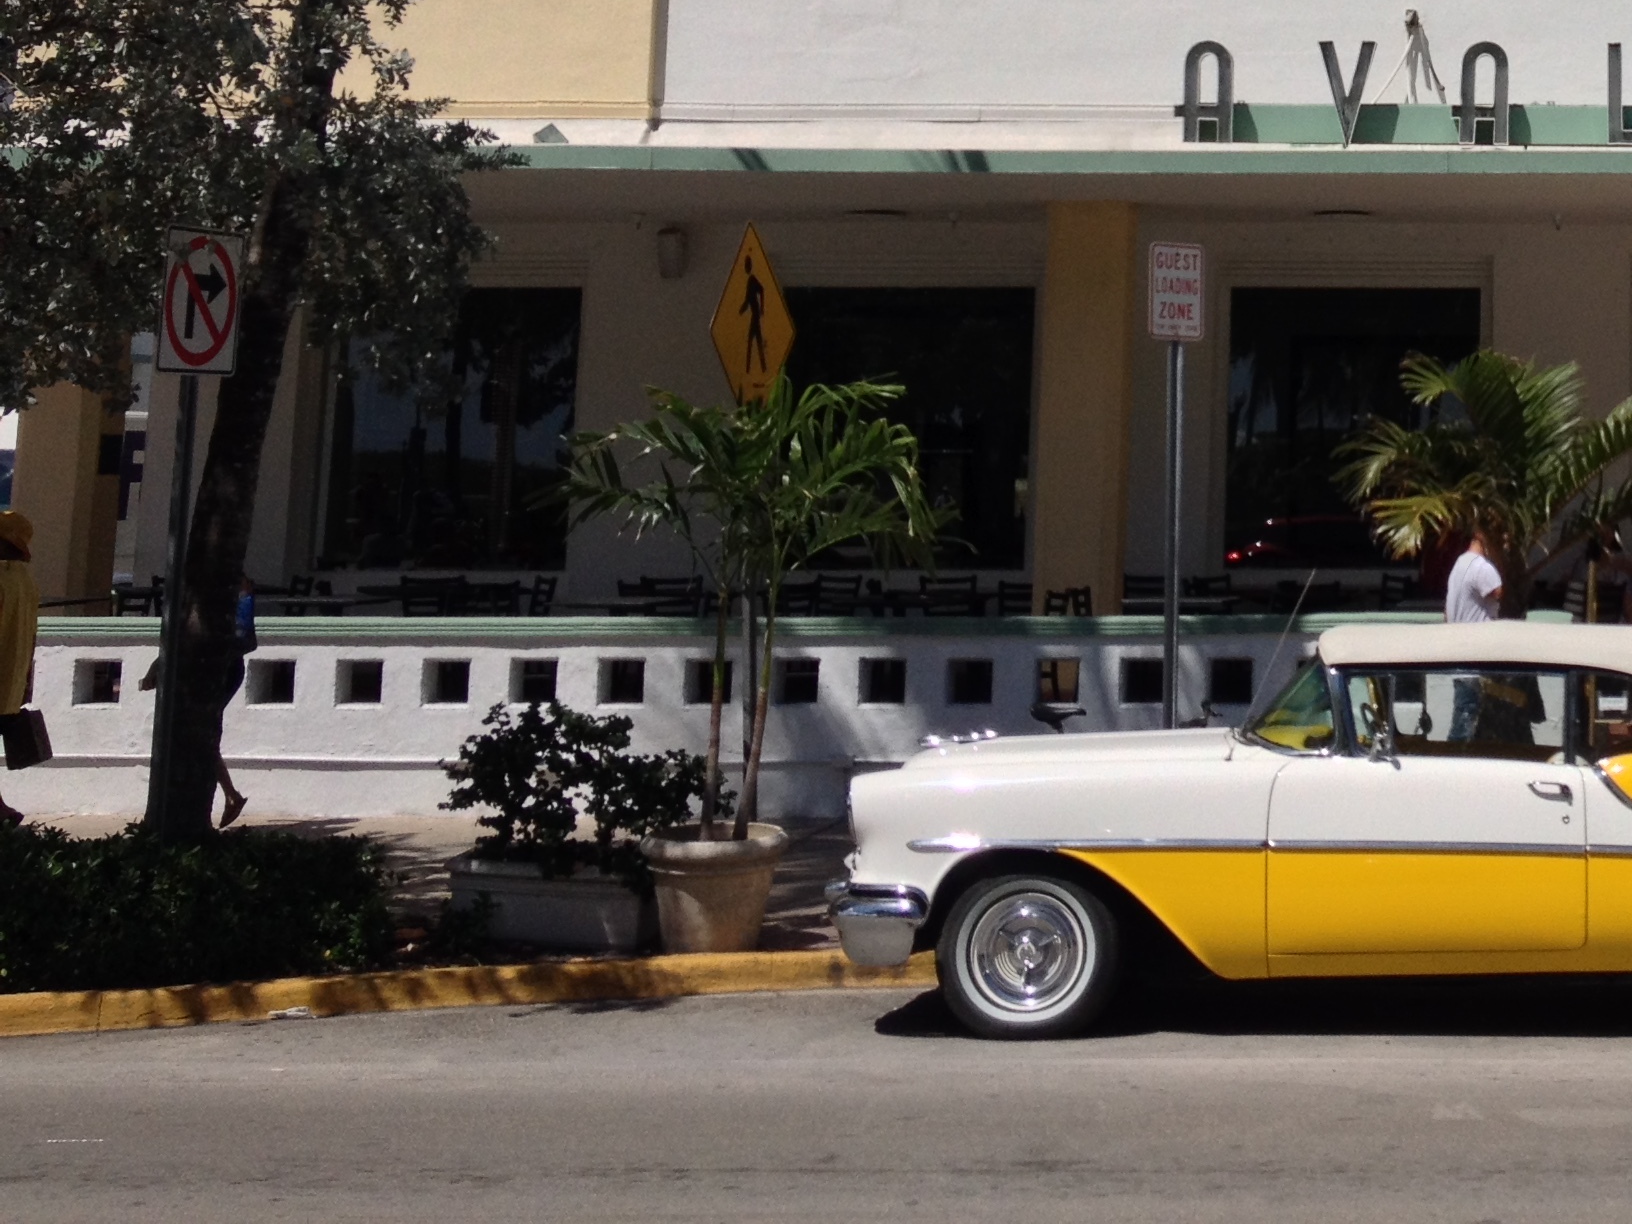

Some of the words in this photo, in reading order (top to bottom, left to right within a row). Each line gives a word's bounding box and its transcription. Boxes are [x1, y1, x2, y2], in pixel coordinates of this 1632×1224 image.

[1156, 252, 1197, 270] GUEST
[1156, 277, 1198, 295] LOADING
[1159, 301, 1193, 320] ZONE
